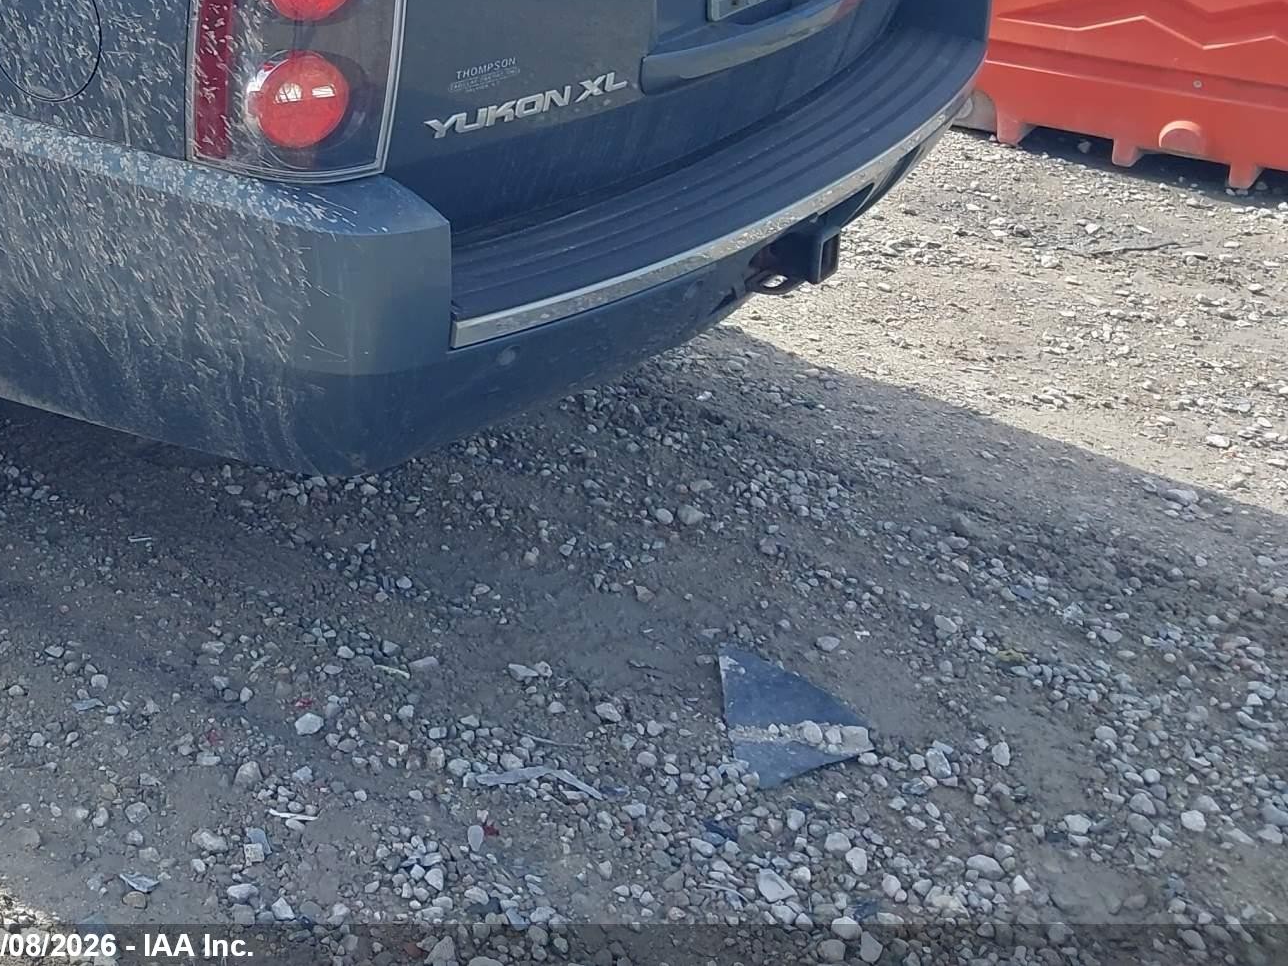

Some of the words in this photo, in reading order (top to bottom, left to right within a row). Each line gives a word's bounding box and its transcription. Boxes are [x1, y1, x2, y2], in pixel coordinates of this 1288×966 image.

[455, 57, 516, 80] THOMPSON
[424, 85, 571, 139] YUKON
[575, 72, 628, 103] XL
